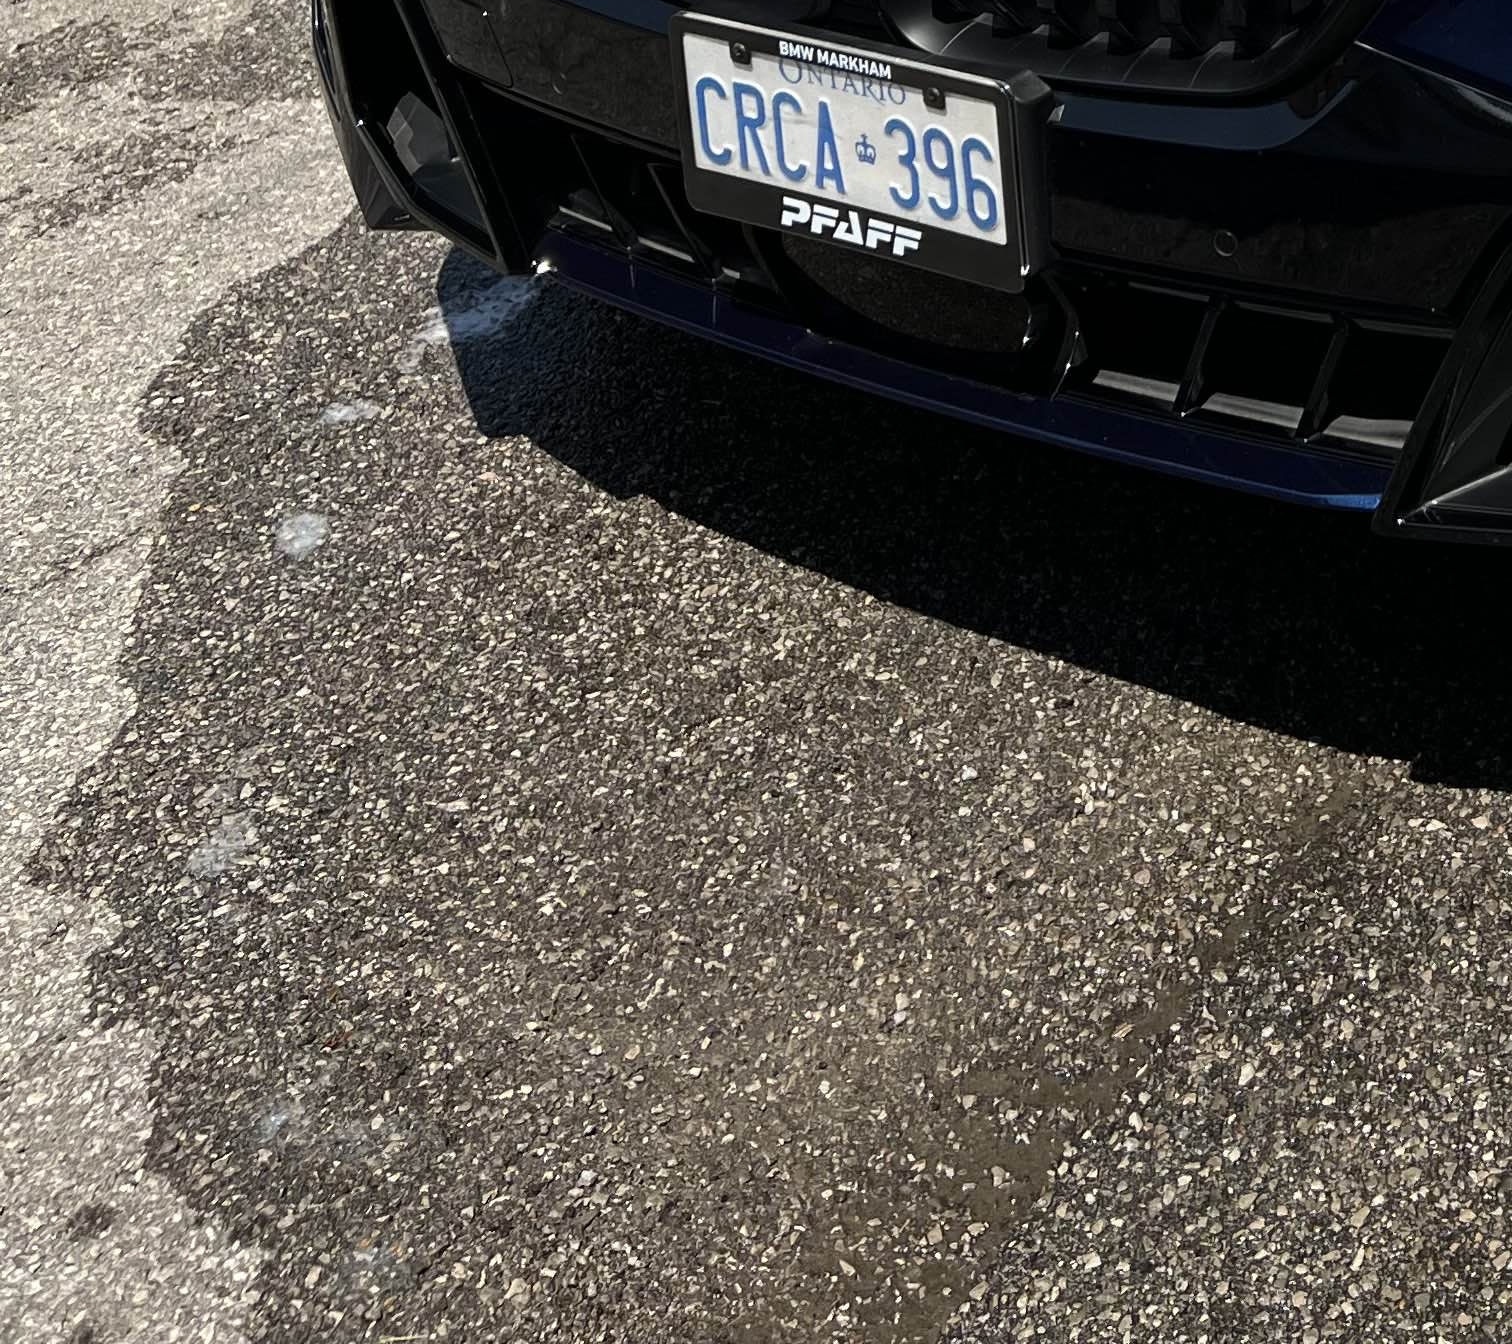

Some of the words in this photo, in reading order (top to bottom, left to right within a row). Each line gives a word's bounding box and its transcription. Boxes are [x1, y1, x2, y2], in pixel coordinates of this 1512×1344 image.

[779, 40, 815, 62] BMW
[817, 49, 892, 80] MARKHAM
[779, 58, 906, 106] ONTARIO
[695, 76, 846, 195] CRCA
[883, 117, 999, 232] 396
[781, 196, 923, 257] PFAFF
